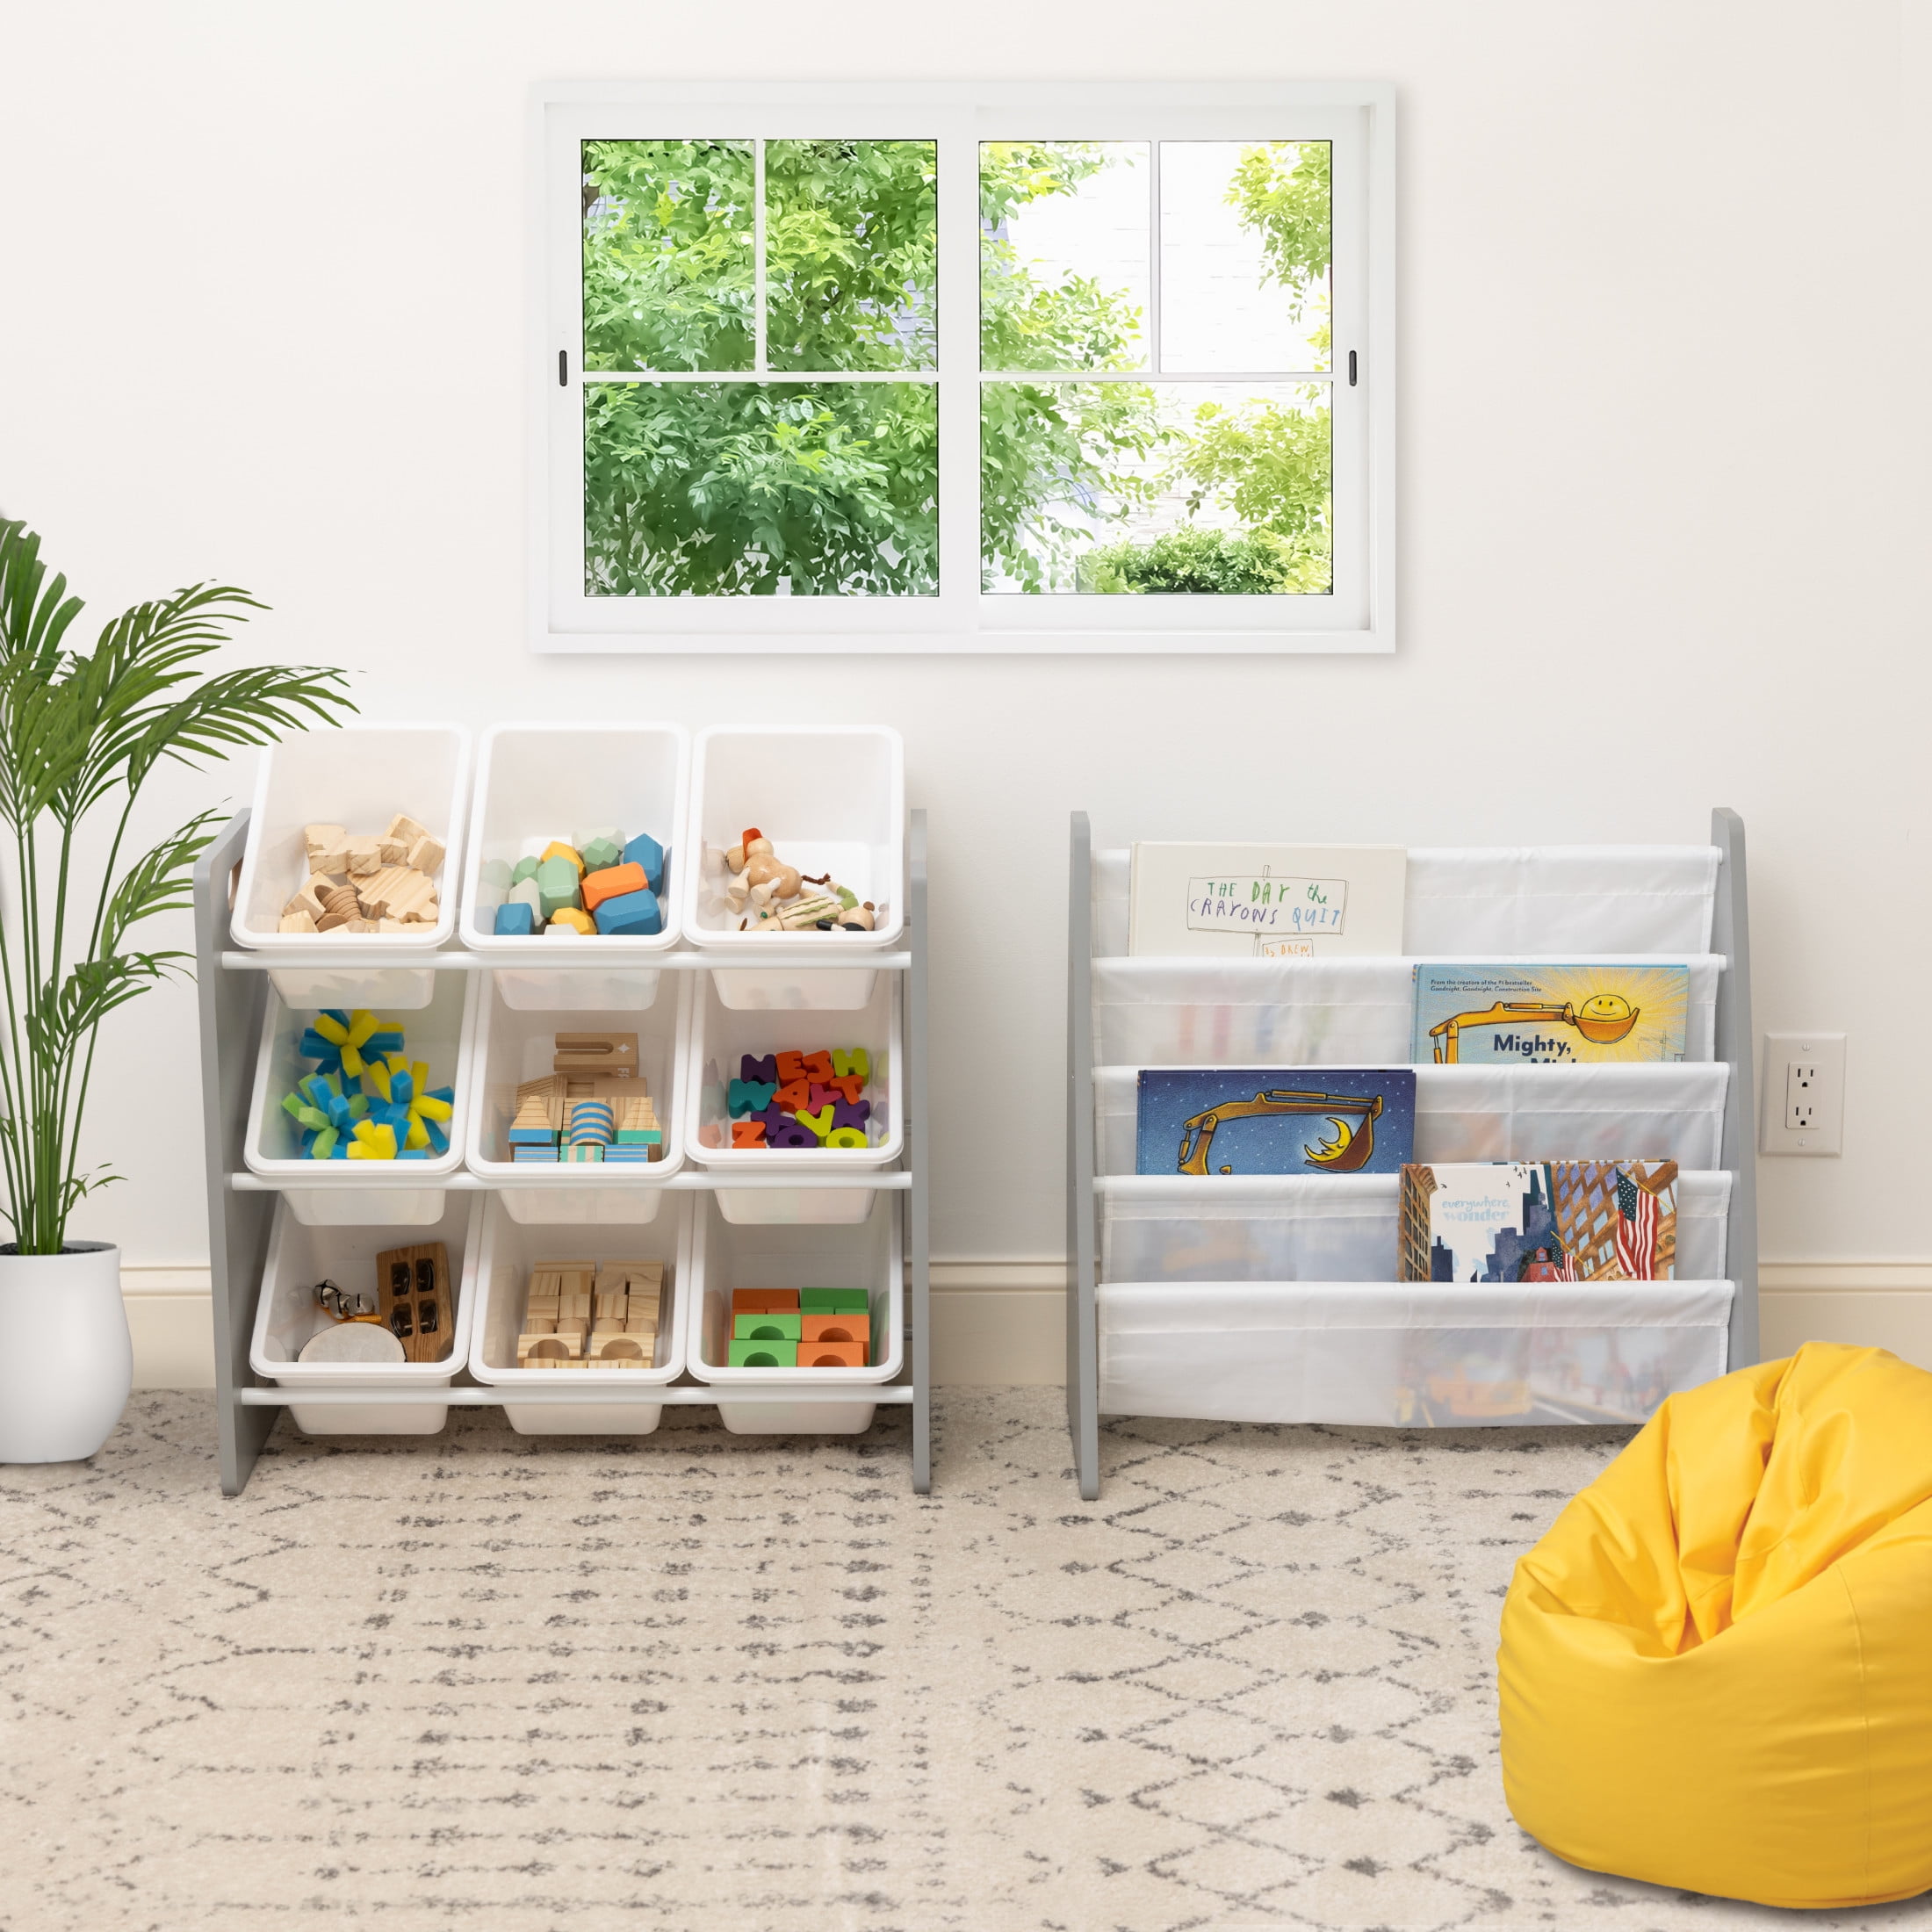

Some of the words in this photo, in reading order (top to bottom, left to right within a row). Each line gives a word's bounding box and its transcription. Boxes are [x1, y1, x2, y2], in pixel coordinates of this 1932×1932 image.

[1208, 882, 1237, 898] THE
[1251, 881, 1290, 905] DAY
[1307, 883, 1327, 905] the
[1190, 898, 1279, 925] CRAYONS
[1292, 906, 1341, 932] QUIT
[1493, 1034, 1572, 1057] Mighty,
[1443, 1208, 1510, 1222] wonder
